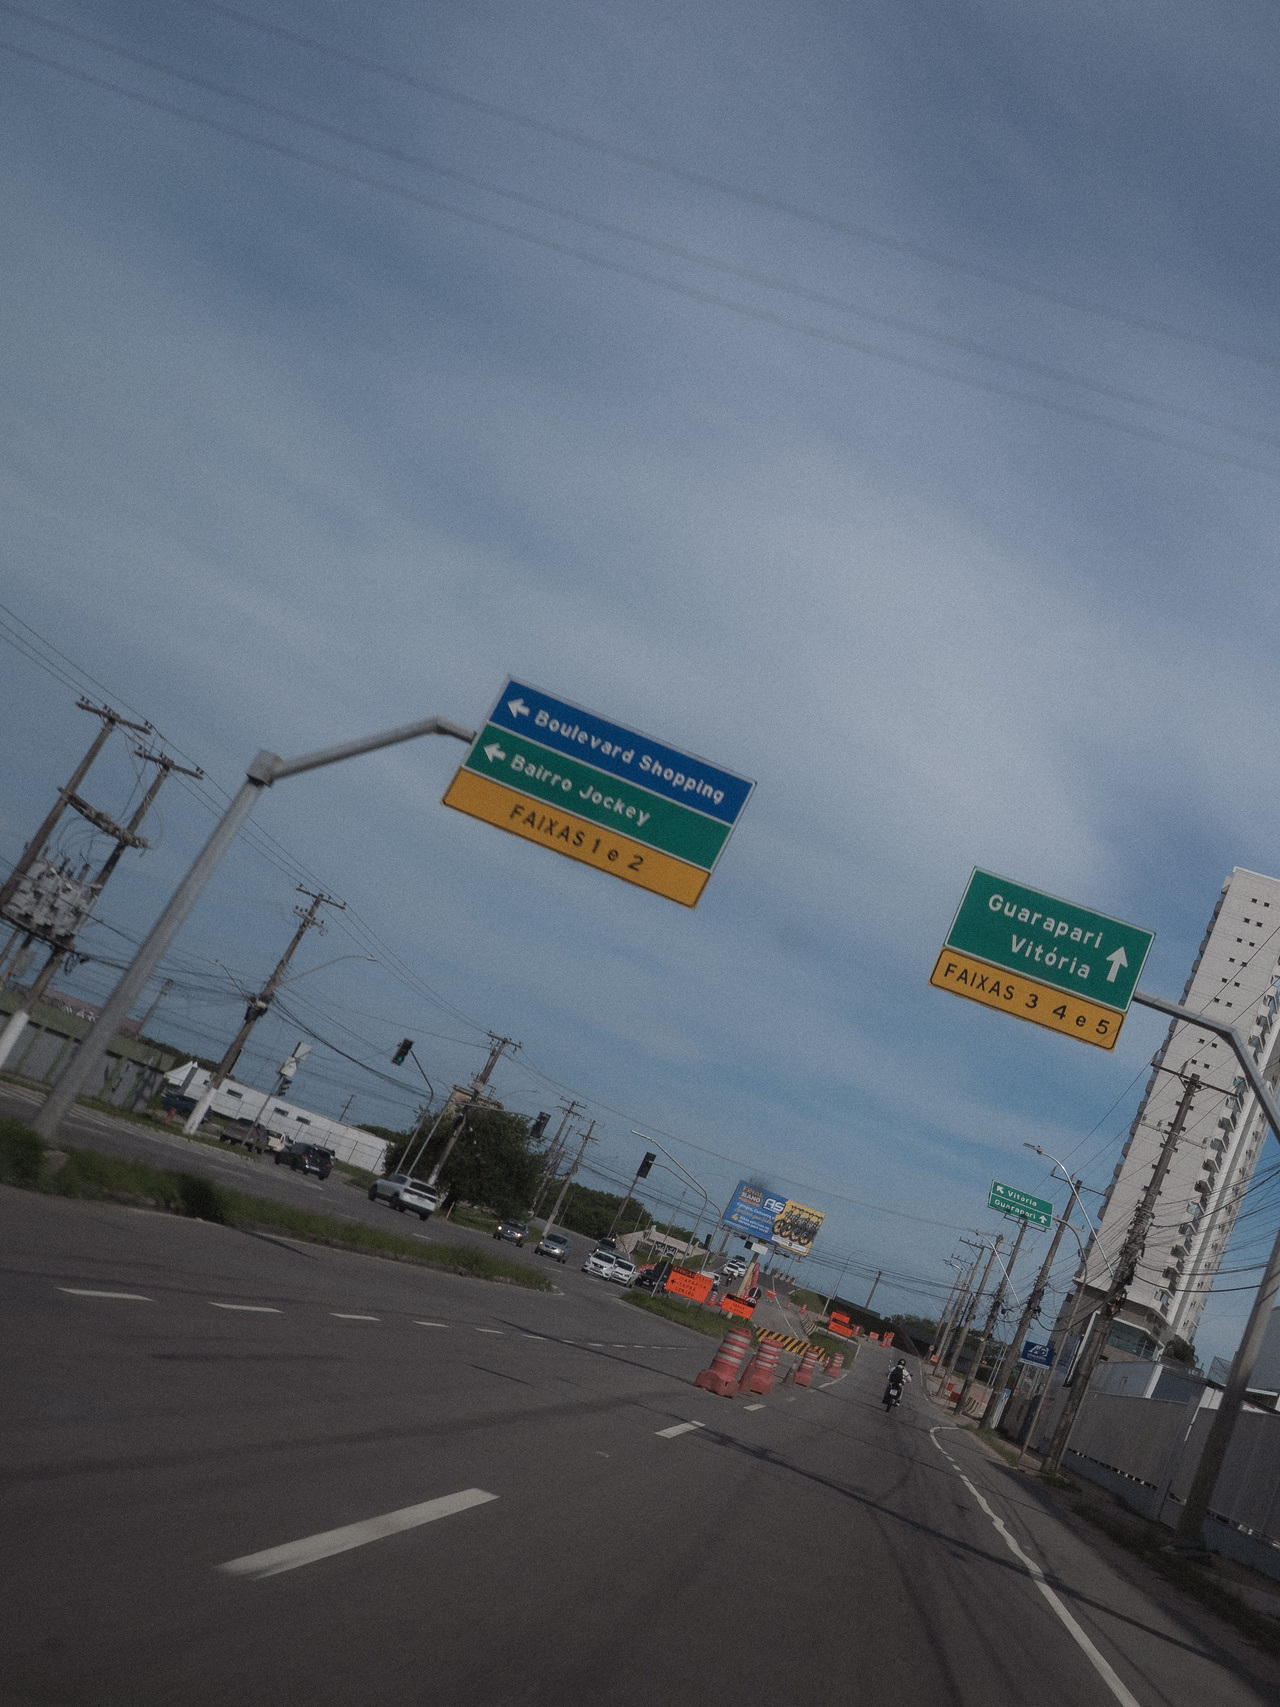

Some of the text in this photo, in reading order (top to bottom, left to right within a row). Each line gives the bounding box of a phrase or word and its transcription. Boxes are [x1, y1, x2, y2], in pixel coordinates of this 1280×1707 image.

[534, 709, 725, 805] Boulevard Shopping
[510, 754, 651, 827] Bairro Jockey
[509, 804, 644, 872] FAIXAS 1 e 2
[988, 894, 1103, 949] Guarapari
[1011, 934, 1091, 979] Vitória
[944, 962, 1110, 1035] FAIXAS 3 4 e 5
[994, 1199, 1036, 1219] Guarapari
[1007, 1190, 1037, 1207] Vitória
